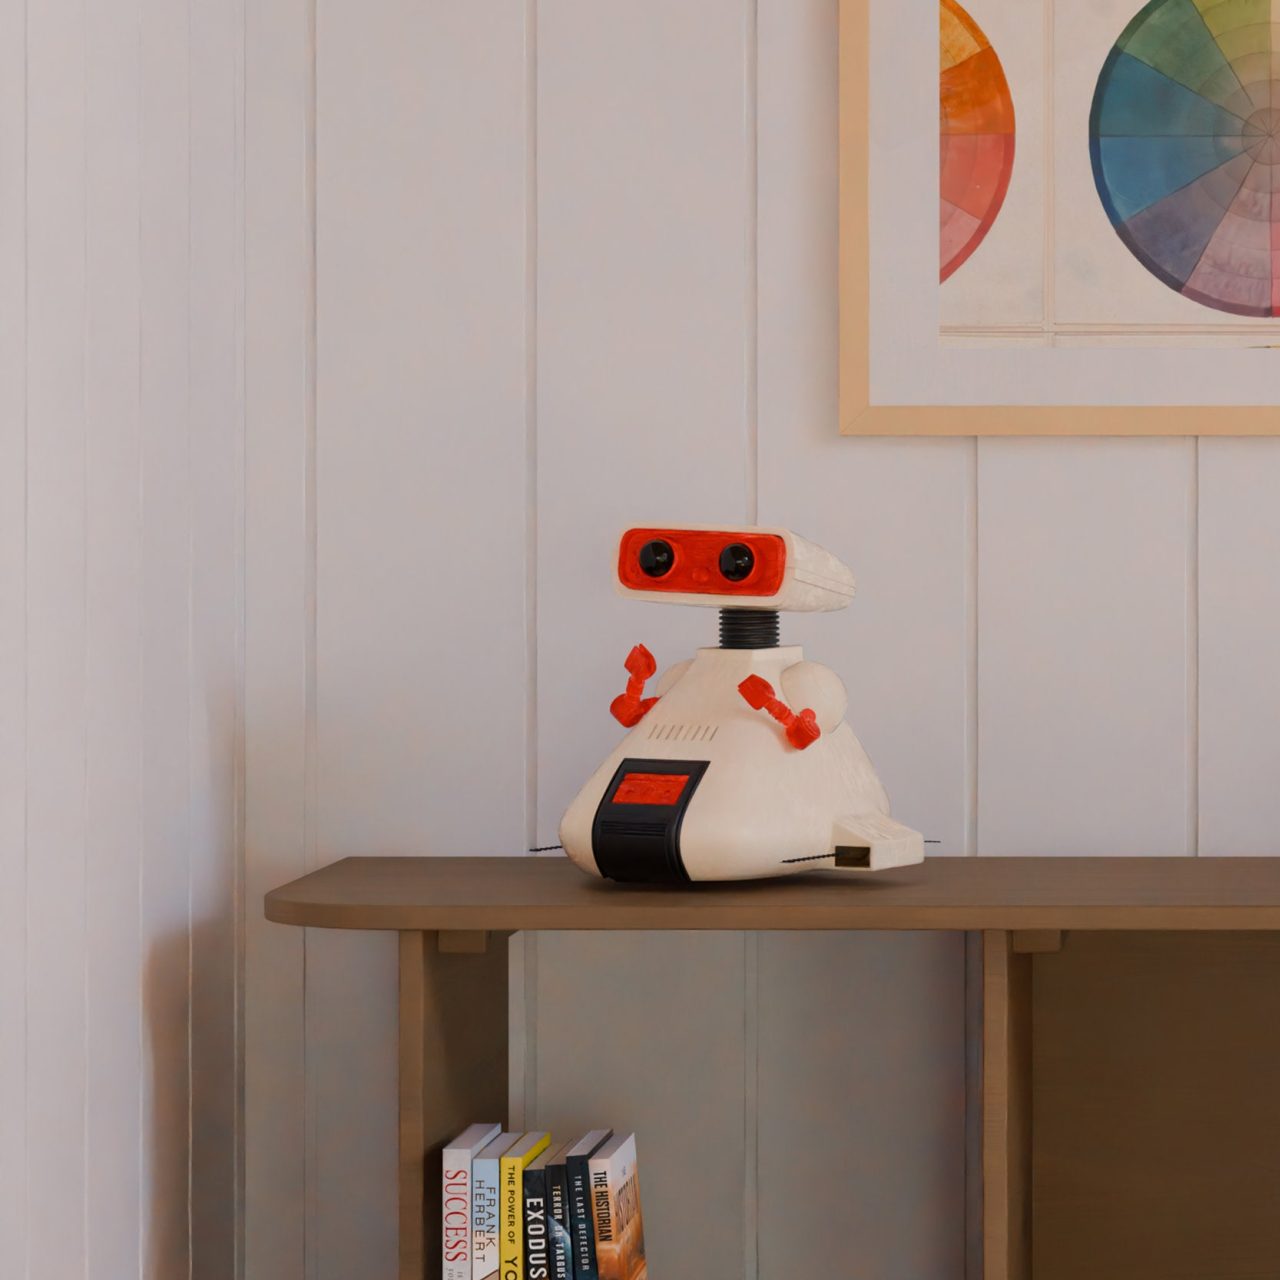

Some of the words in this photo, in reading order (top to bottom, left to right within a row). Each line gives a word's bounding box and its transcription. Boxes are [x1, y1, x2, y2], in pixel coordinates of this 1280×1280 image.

[507, 1165, 516, 1186] THE
[574, 1175, 583, 1192] THE
[593, 1170, 608, 1189] THE
[444, 1169, 468, 1263] SUCCESS
[486, 1186, 496, 1248] FRANK
[507, 1190, 516, 1227] POWER
[552, 1185, 564, 1220] TERROR
[575, 1196, 585, 1219] LAST
[594, 1190, 613, 1242] HISTORIAN
[475, 1180, 485, 1262] HERBERT
[507, 1231, 516, 1245] OF
[526, 1197, 548, 1279] EXODUS
[555, 1243, 566, 1279] TARGUS
[578, 1223, 590, 1271] DEFECTOR
